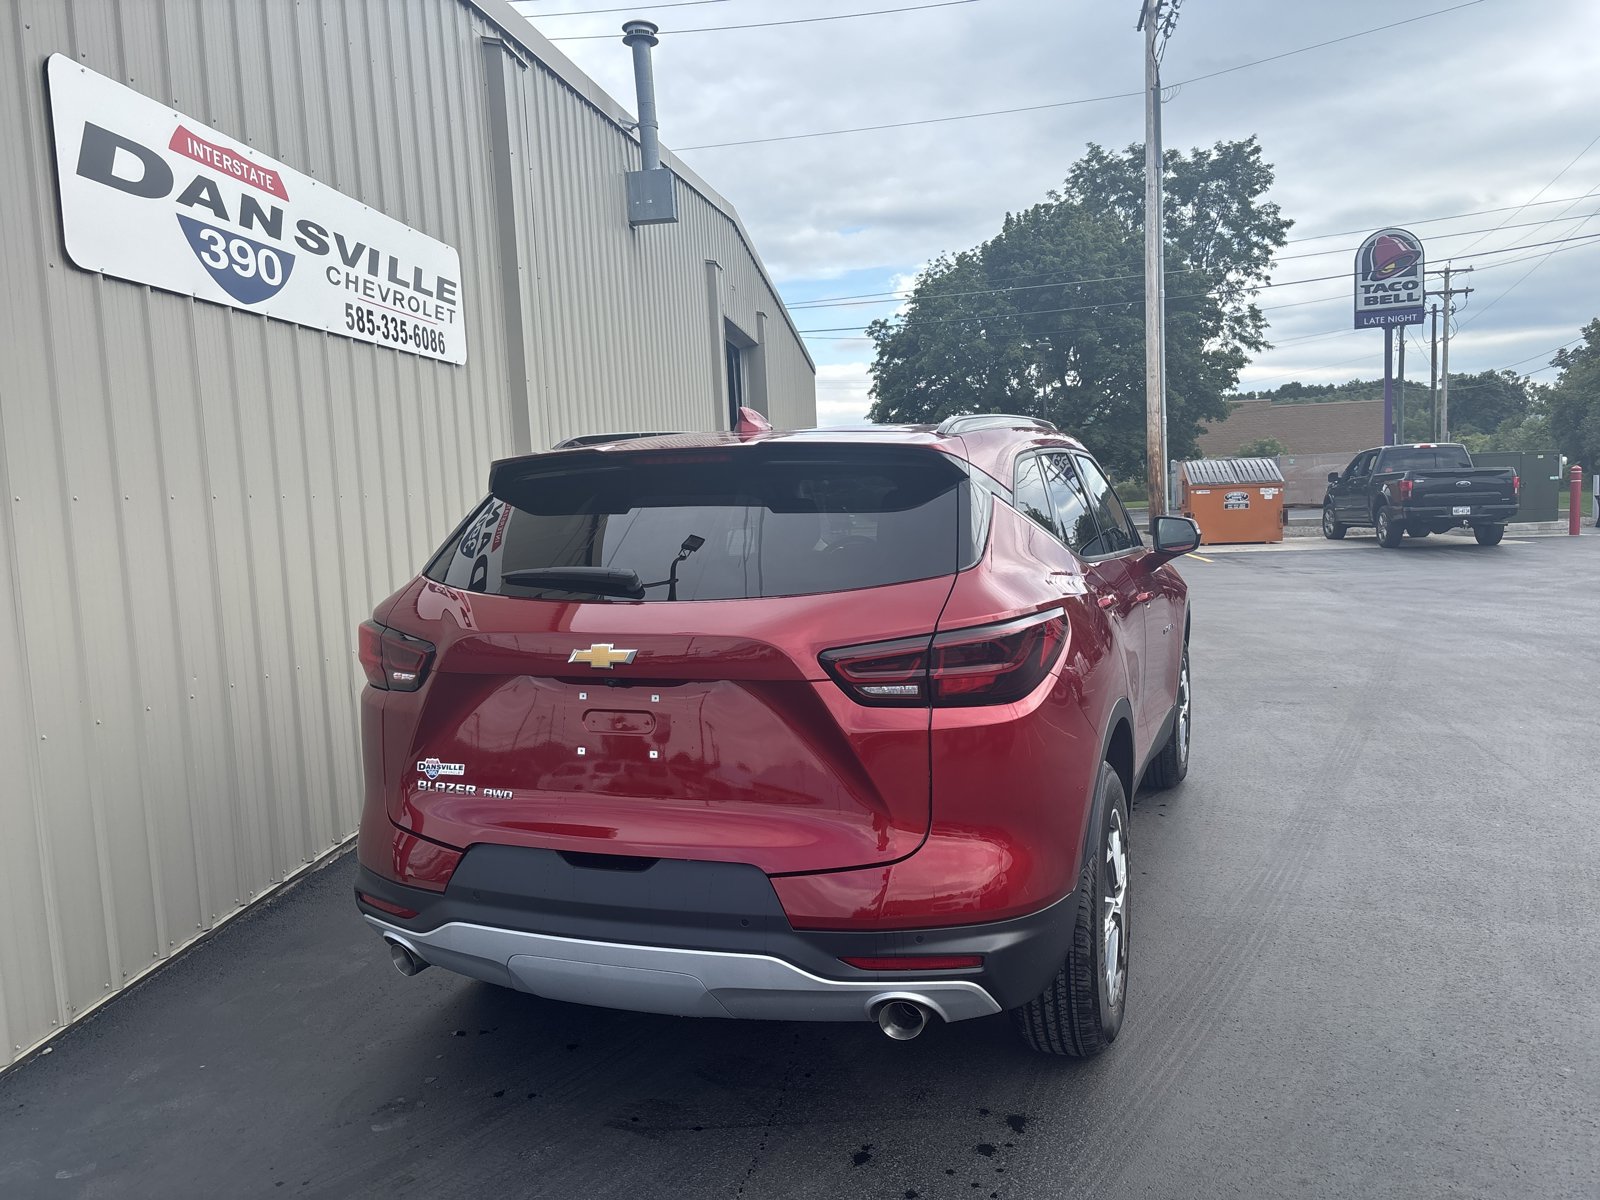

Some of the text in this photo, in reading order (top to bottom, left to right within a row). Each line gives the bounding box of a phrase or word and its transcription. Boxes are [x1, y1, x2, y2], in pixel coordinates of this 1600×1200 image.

[186, 137, 275, 191] INTERSTATE
[76, 121, 457, 306] DANSVILLE
[199, 228, 283, 286] 390
[326, 265, 456, 324] CHEVROLET
[1360, 280, 1419, 294] TACO
[1364, 292, 1420, 306] BELL
[344, 303, 446, 355] 585-335-6086
[1363, 313, 1417, 325] LATE NIGHT
[418, 762, 464, 771] DANSVILLE
[417, 780, 514, 799] BLAZER AWD
